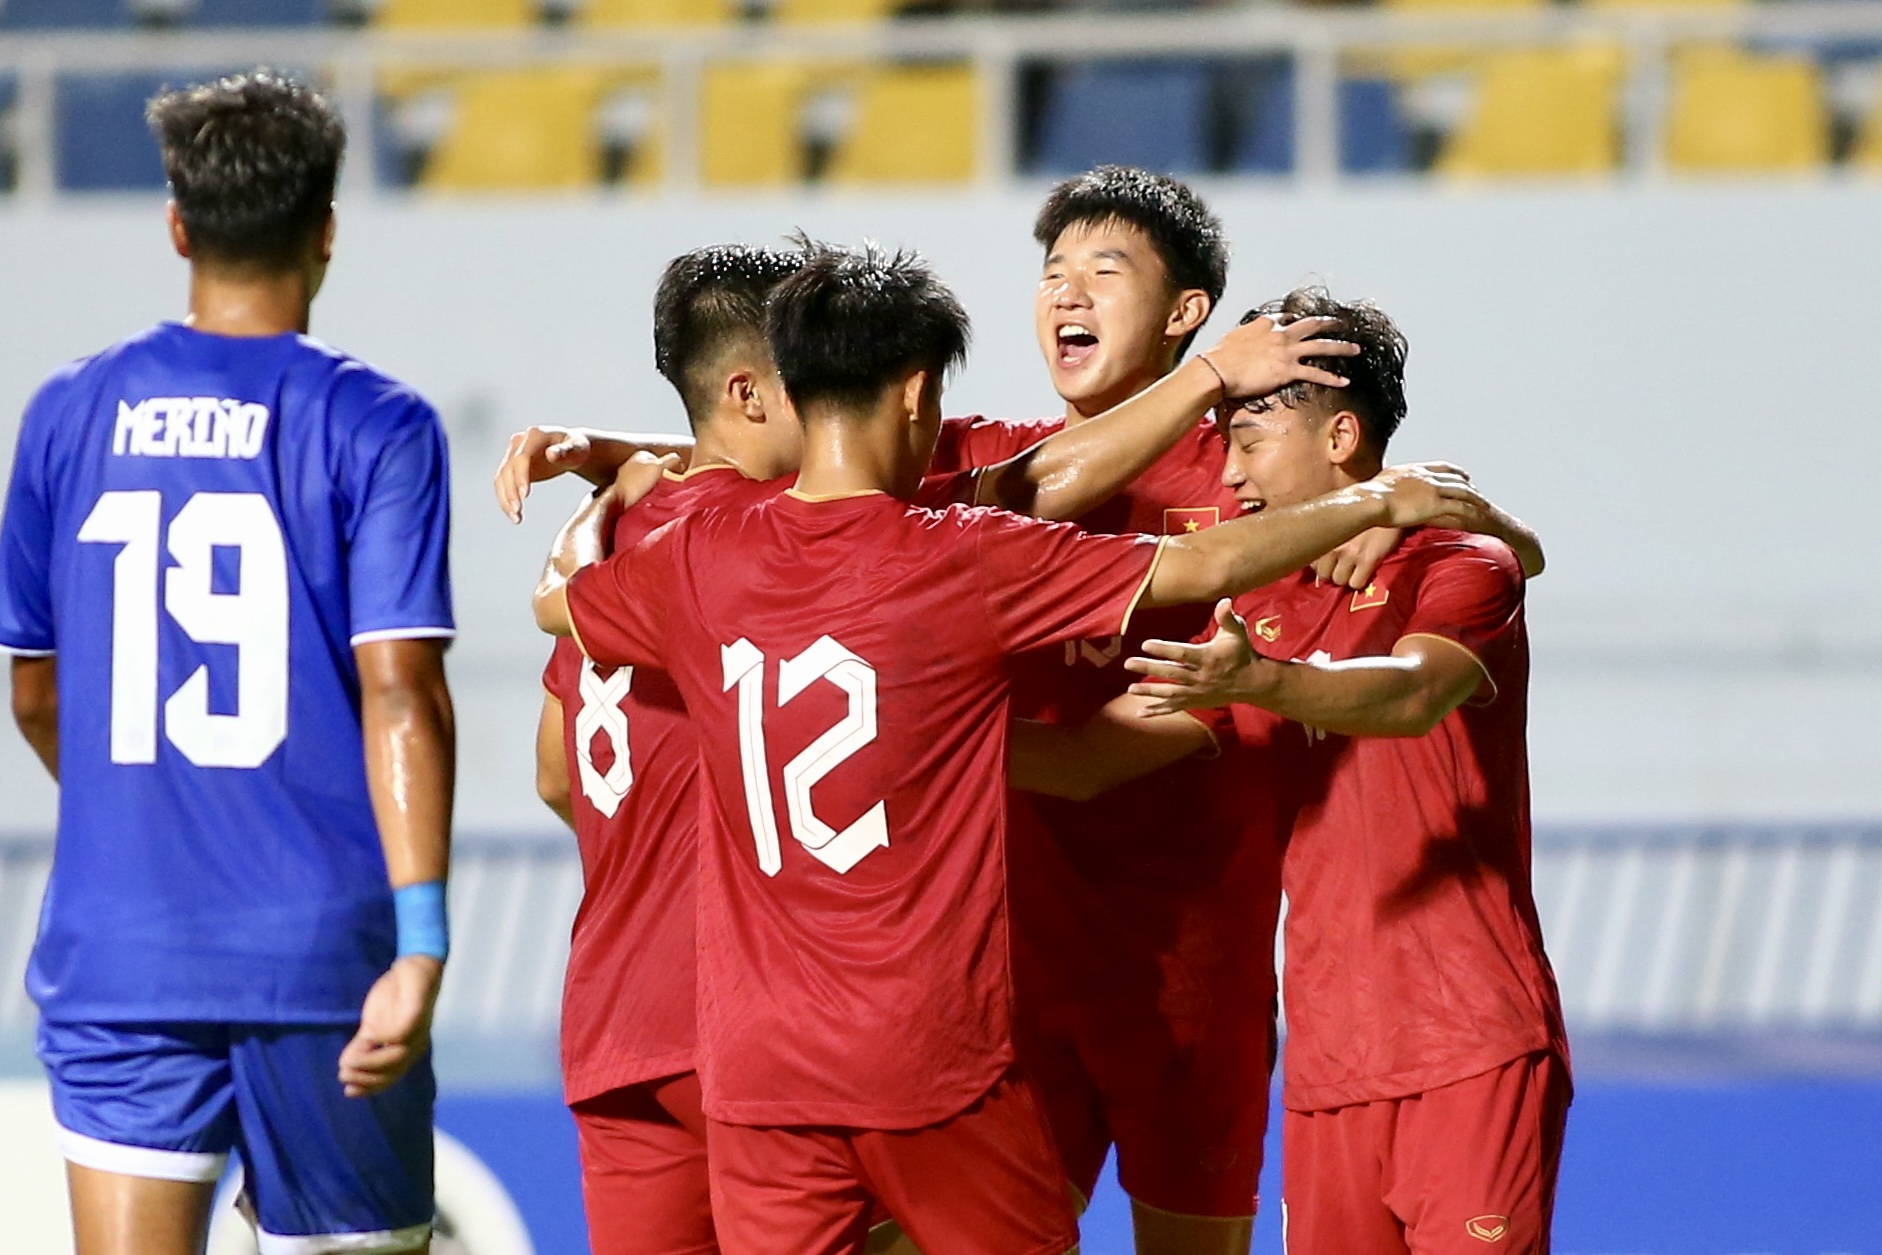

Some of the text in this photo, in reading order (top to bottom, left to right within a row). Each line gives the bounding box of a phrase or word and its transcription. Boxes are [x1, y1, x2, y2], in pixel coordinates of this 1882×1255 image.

[112, 397, 270, 460] MERIÑO
[76, 490, 290, 769] 19
[575, 656, 634, 819] 8
[721, 634, 891, 877] 12
